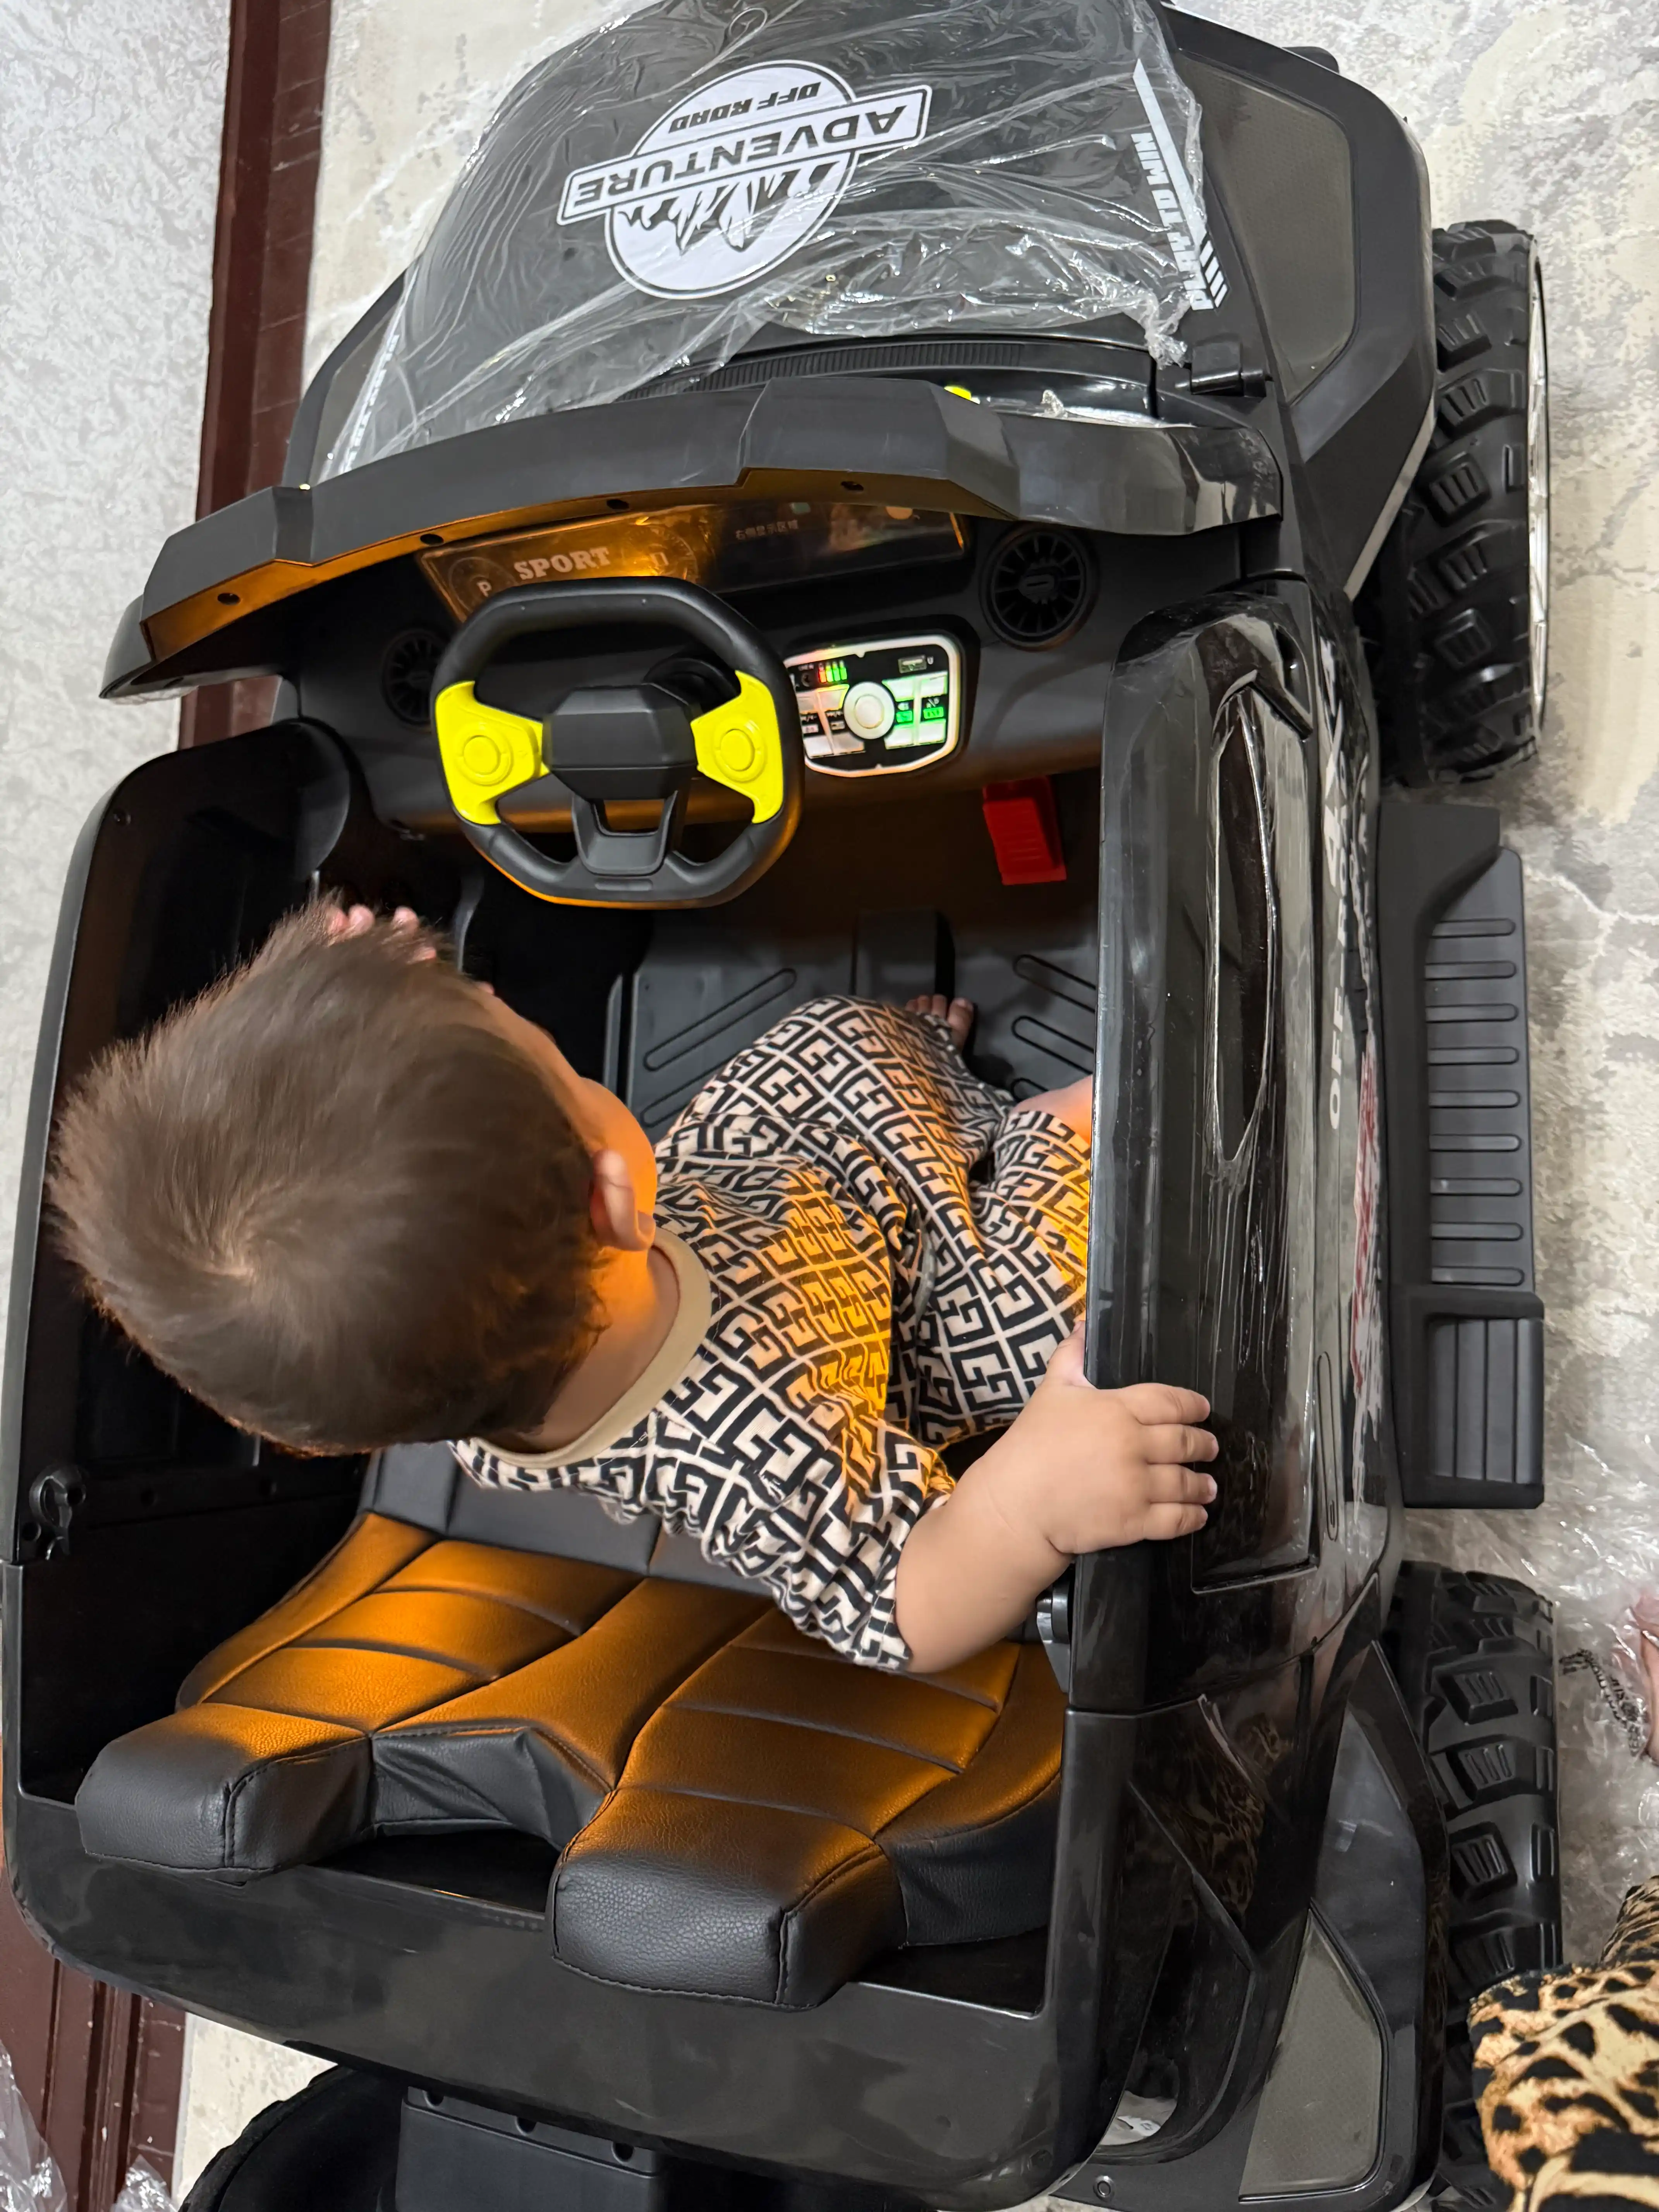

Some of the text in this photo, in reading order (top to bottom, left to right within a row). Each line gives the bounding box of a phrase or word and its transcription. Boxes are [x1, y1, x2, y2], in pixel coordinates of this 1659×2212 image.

[668, 81, 821, 133] OFF ROAD
[576, 104, 908, 206] ADVENTURE
[1130, 132, 1214, 311] PLAY TO WIN
[476, 579, 493, 597] P
[513, 546, 611, 580] SPORT
